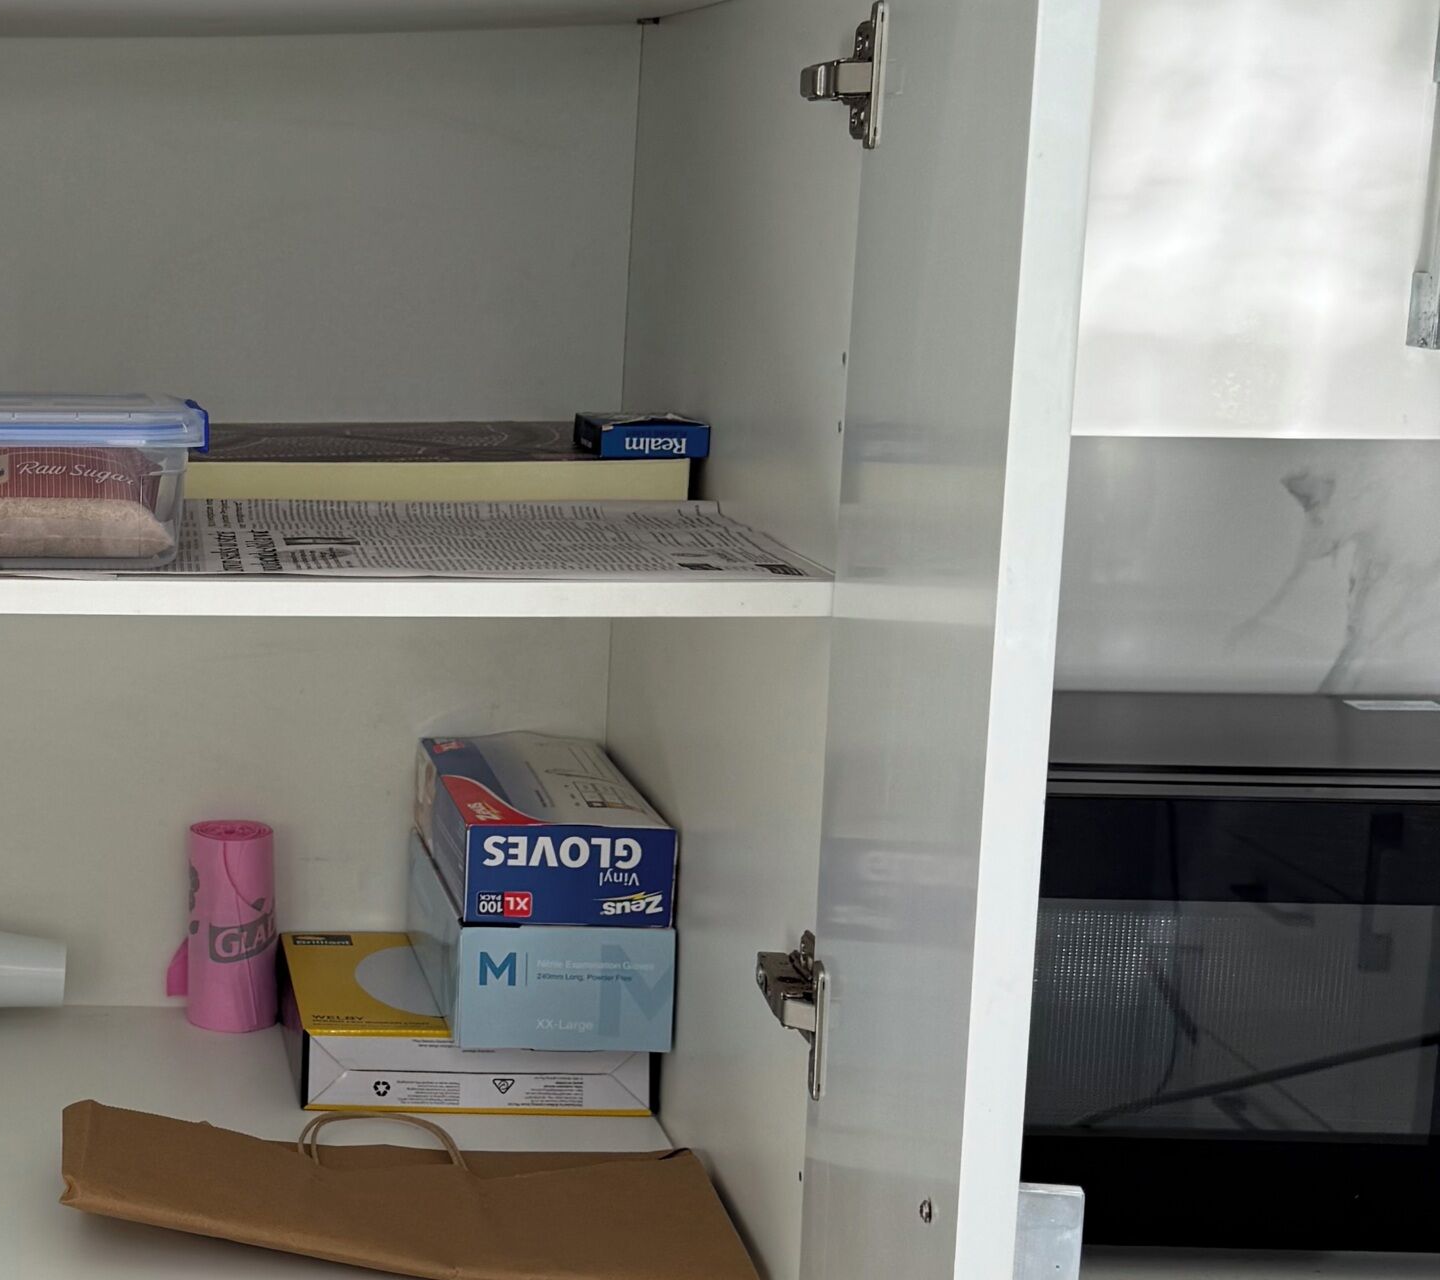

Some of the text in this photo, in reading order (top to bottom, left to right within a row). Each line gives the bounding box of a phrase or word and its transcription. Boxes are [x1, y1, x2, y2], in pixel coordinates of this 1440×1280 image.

[625, 437, 687, 454] Realm
[17, 461, 67, 475] Raw
[69, 464, 135, 485] Sugar
[483, 835, 642, 869] GLOVES
[599, 868, 639, 886] Vinyl
[479, 900, 503, 913] 100
[505, 896, 529, 911] XL
[602, 894, 663, 916] Zeus
[479, 951, 517, 986] M
[536, 1019, 593, 1031] XX-Large
